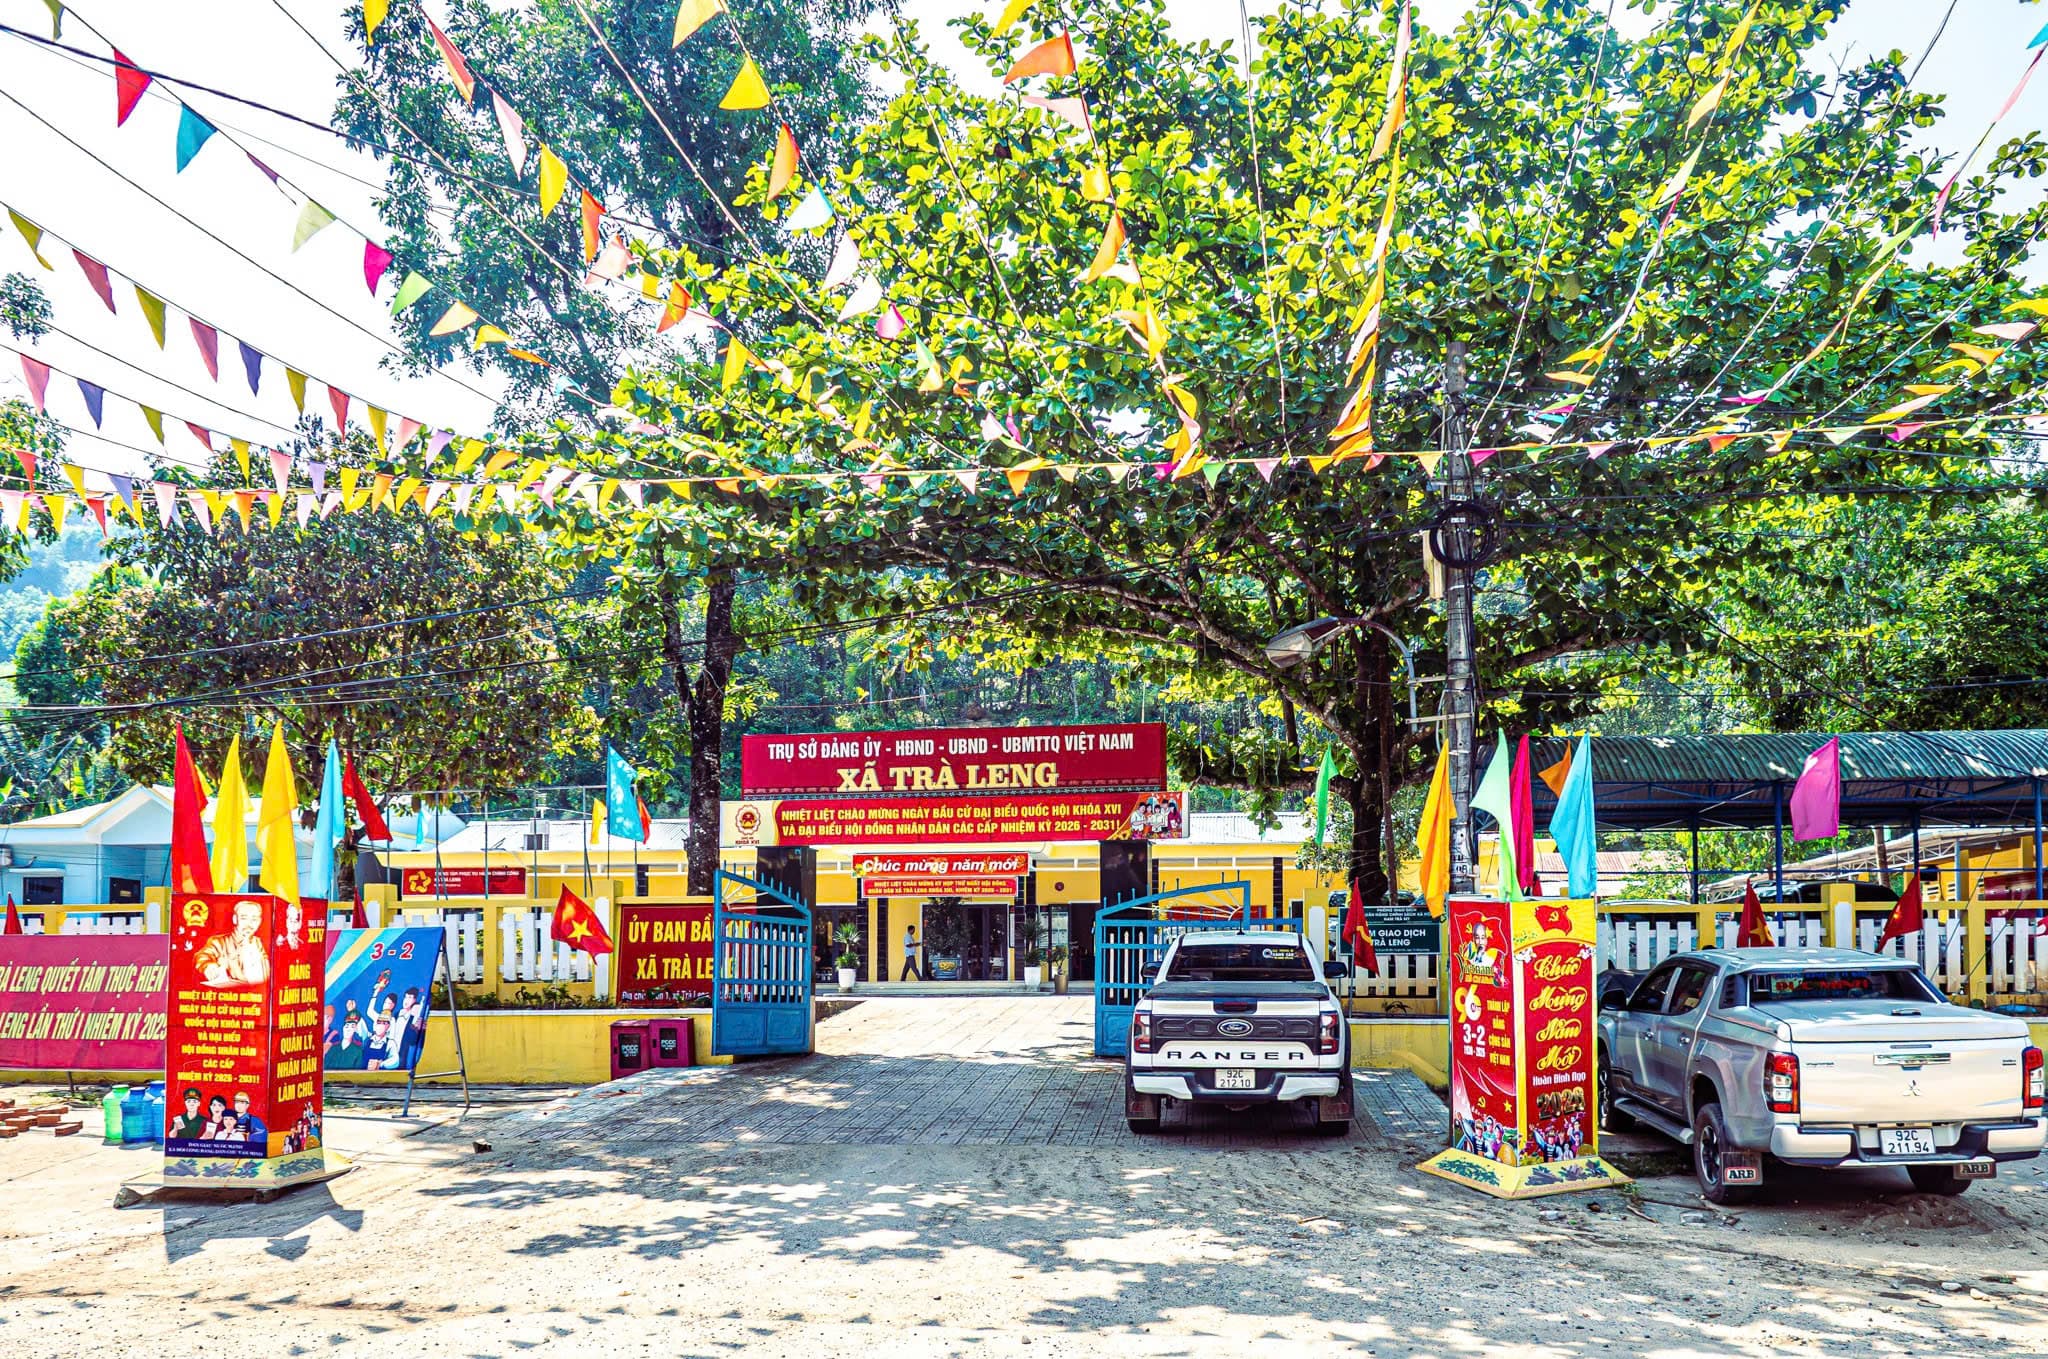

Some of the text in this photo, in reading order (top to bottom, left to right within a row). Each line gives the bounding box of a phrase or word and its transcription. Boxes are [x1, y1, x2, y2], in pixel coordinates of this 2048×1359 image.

[768, 744, 793, 762] TRỤ
[799, 737, 817, 758] SỞ
[821, 737, 859, 758] ĐẢNG
[864, 736, 882, 757] ỦY
[896, 739, 934, 756] HĐND
[949, 738, 988, 754] UBND
[1003, 735, 1060, 753] UBMTTQ
[1065, 731, 1094, 754] VIỆT
[1100, 733, 1134, 750] NAM
[837, 757, 1060, 792] XÃ TRÀ LENG
[782, 808, 812, 822] NHIỆT
[814, 808, 835, 822] LIỆT
[838, 808, 865, 819] CHÀO
[868, 806, 899, 819] MỪNG
[902, 806, 930, 818] NGÀY
[957, 804, 972, 818] CỬ
[974, 807, 991, 820] ĐẠI
[994, 803, 1018, 818] BIỂU
[1021, 803, 1049, 818] QUỐC
[1052, 803, 1070, 818] HỘI
[1073, 802, 1100, 816] KHÓA
[1104, 804, 1121, 814] XVI
[782, 819, 1120, 838] VÀ ĐẠI BIỂU HỘI ĐỒNG NHÂN DÂN CÁC CẤP NHIỆM KỲ 2026 2031!
[862, 856, 1018, 874] Chúc mừng năm mới
[308, 928, 324, 943] XIV
[628, 914, 686, 942] ỦY BAN
[1404, 930, 1426, 938] DỊCH
[370, 942, 385, 960] 3
[399, 940, 415, 960] 2
[288, 960, 310, 980] ĐẢNG
[636, 953, 692, 980] XÃ TRÀ
[1534, 955, 1582, 981] Chúc
[8, 958, 168, 998] LENG QUYẾT TÂM THỰC HIỆN
[178, 990, 262, 1002] NHIỆT LIỆT CHÀO MỪNG
[279, 985, 300, 1006] LÃNH
[1455, 984, 1482, 1022] 96
[1530, 986, 1588, 1012] Mừng
[179, 1004, 199, 1014] NGÀY
[1487, 998, 1510, 1014] THÀNH LẬP
[26, 1003, 54, 1039] LẦN
[52, 1007, 80, 1040] THỨ
[74, 1013, 85, 1039] I
[81, 1007, 125, 1046] NHIỆM
[121, 1006, 143, 1040] KỲ
[184, 1016, 254, 1029] QUỐC HỘI KHÓA XVI
[278, 1004, 318, 1029] NHÀ NƯỚC
[1492, 1015, 1506, 1030] ĐẢNG
[198, 1031, 208, 1040] VÀ
[1536, 1018, 1582, 1042] Năm
[281, 1031, 315, 1056] QUẢN LÝ,
[1488, 1033, 1510, 1048] CỘNG SẢN
[182, 1044, 194, 1055] HỘI
[218, 1045, 239, 1056] NHÂN
[240, 1046, 256, 1056] DÂN
[1167, 1051, 1305, 1060] RANGER
[1489, 1051, 1510, 1066] VIỆT NAM
[1537, 1046, 1582, 1070] Mới
[203, 1058, 235, 1068] CÁC CẤP
[277, 1056, 317, 1078] NHÂN DÂN
[178, 1070, 202, 1082] NHIỆM
[203, 1072, 212, 1081] KỲ
[1226, 1070, 1244, 1079] 92C
[278, 1076, 315, 1102] LÀM CHỦ.
[1896, 1130, 1918, 1142] 92C
[1888, 1142, 1930, 1154] 211.94
[1728, 1169, 1754, 1179] ARB
[1961, 1164, 1989, 1174] ARB
